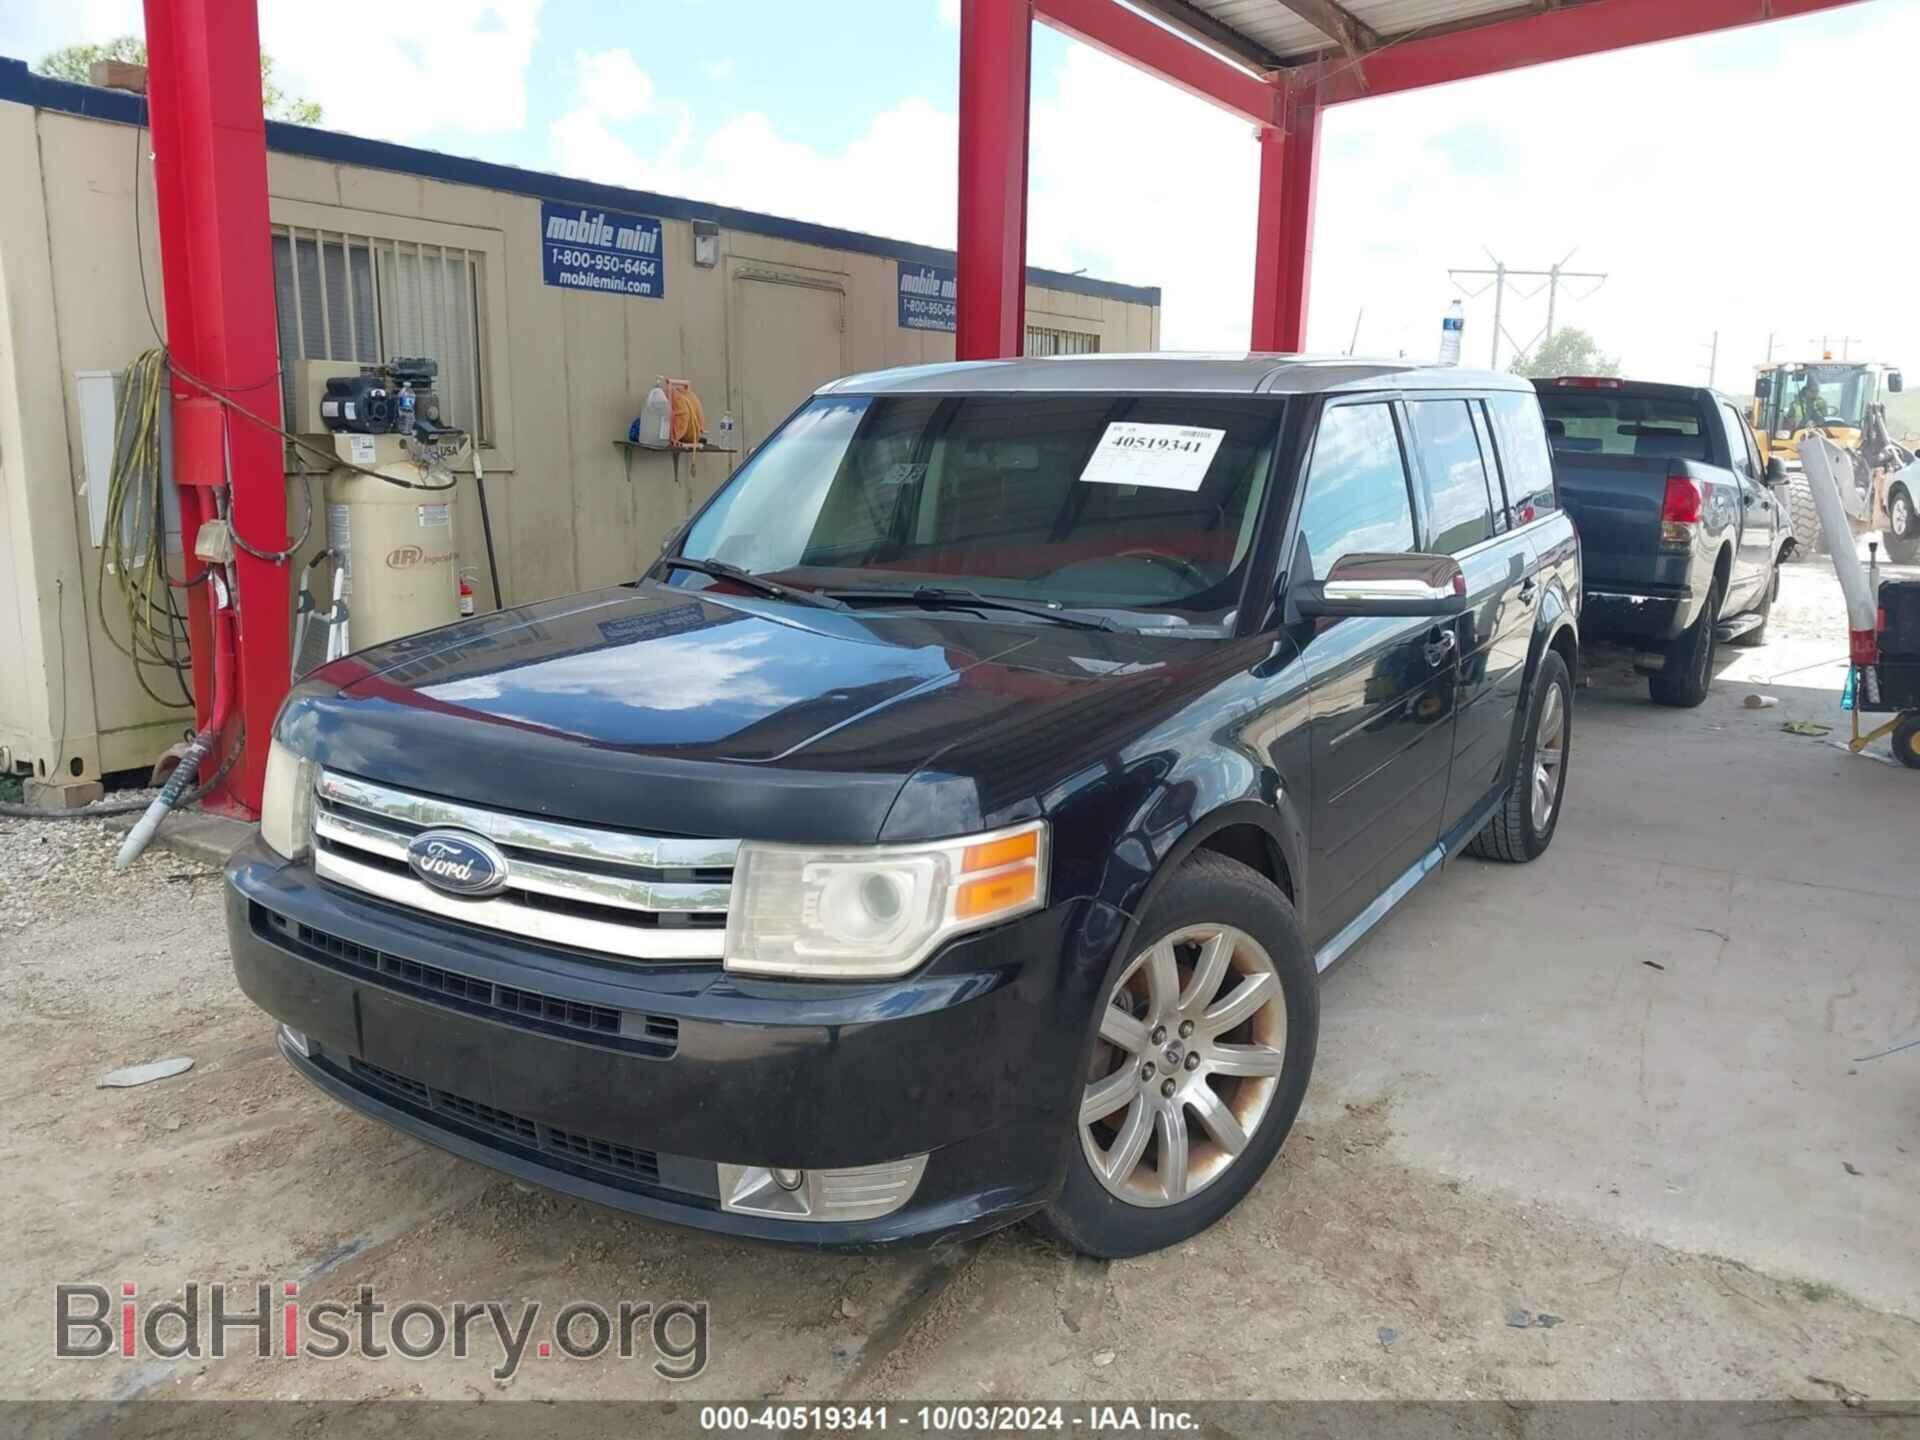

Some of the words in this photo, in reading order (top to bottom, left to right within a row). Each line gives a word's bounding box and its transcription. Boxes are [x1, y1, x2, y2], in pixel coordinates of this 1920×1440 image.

[546, 210, 614, 247] mobile
[616, 224, 660, 254] mini
[552, 248, 656, 277] 1-800-950-6464
[560, 271, 652, 294] mobilemini.com
[900, 267, 941, 296] mobile
[941, 277, 957, 298] mi
[1112, 435, 1202, 453] 40519341
[420, 841, 474, 880] Ford
